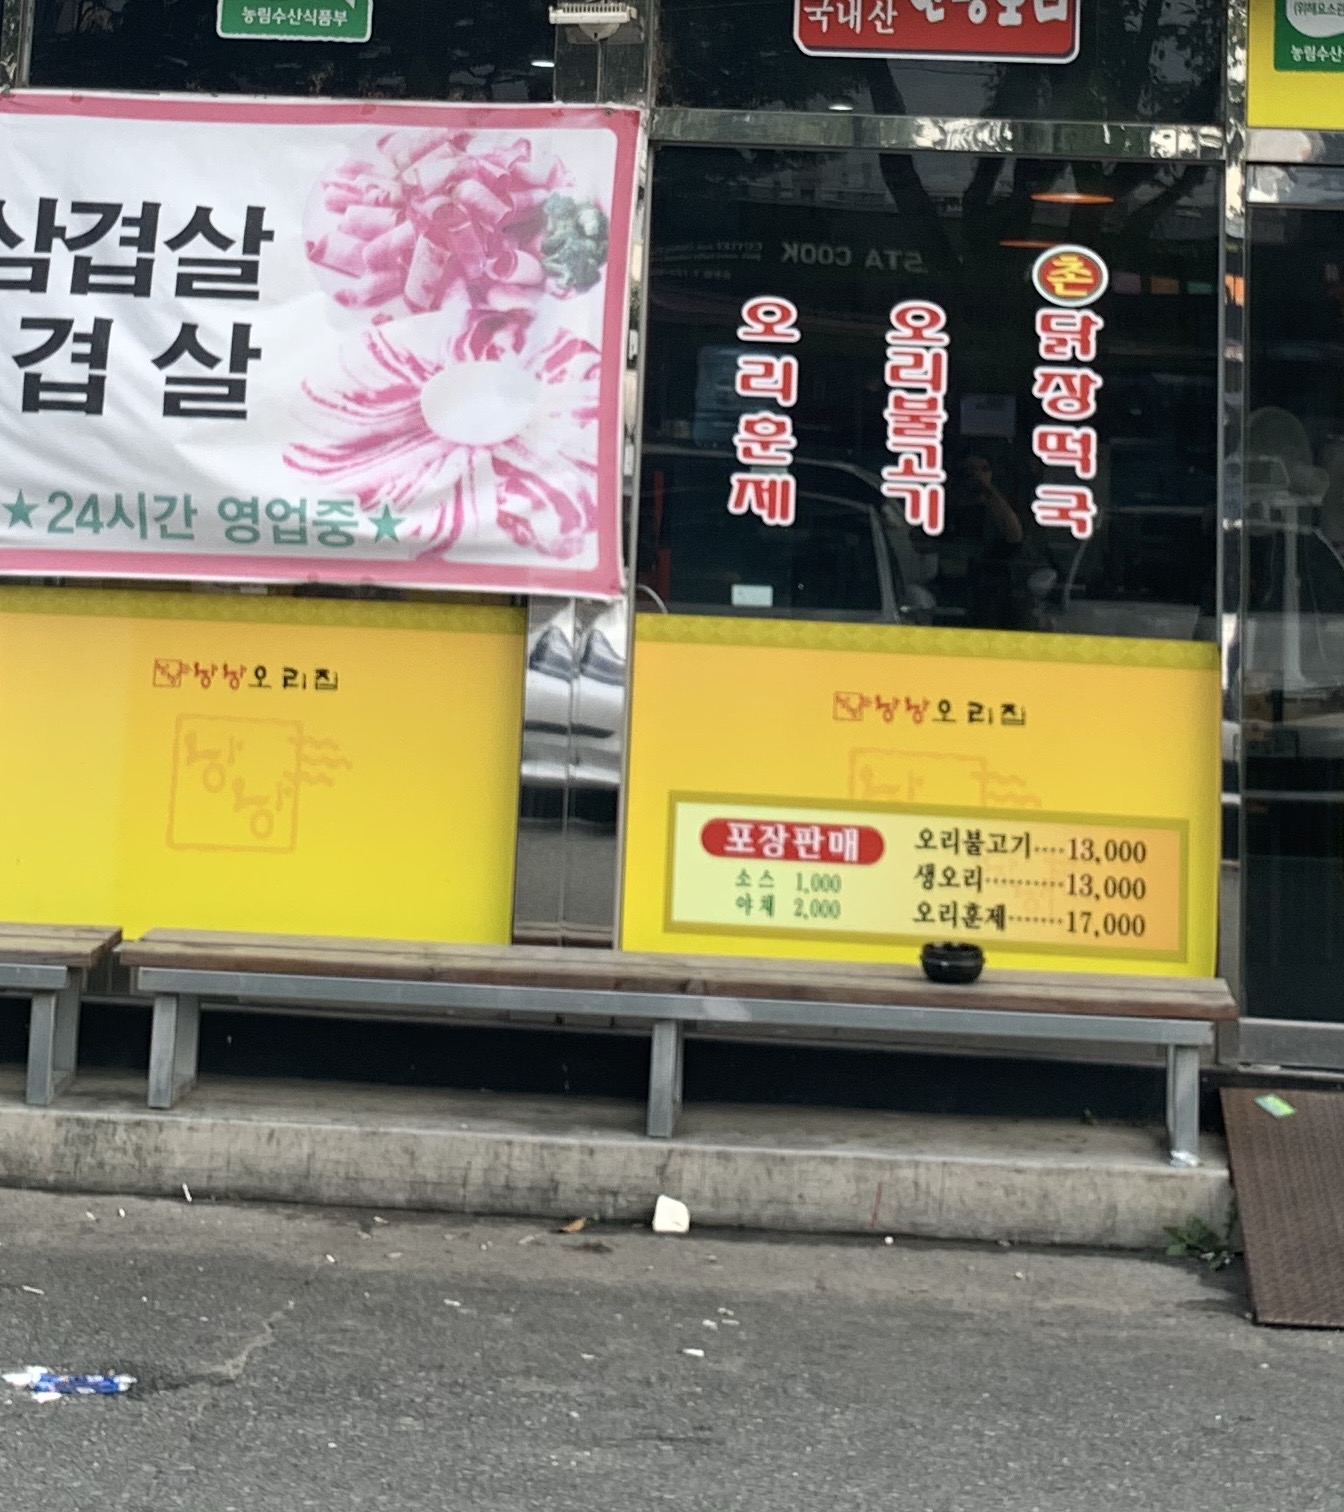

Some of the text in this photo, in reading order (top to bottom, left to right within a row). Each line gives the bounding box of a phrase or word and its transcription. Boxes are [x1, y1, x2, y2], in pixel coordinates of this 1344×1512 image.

[242, 5, 348, 29] 농림수산식품부
[728, 296, 800, 526] 오리훈제
[882, 300, 950, 536] 오리불고기
[725, 821, 858, 861] 포장판매
[1067, 838, 1147, 866] 13,000
[796, 873, 841, 894] 1,000
[1066, 875, 1146, 903] 13,000
[794, 897, 840, 920] 2,000
[1065, 911, 1145, 940] 17,000
